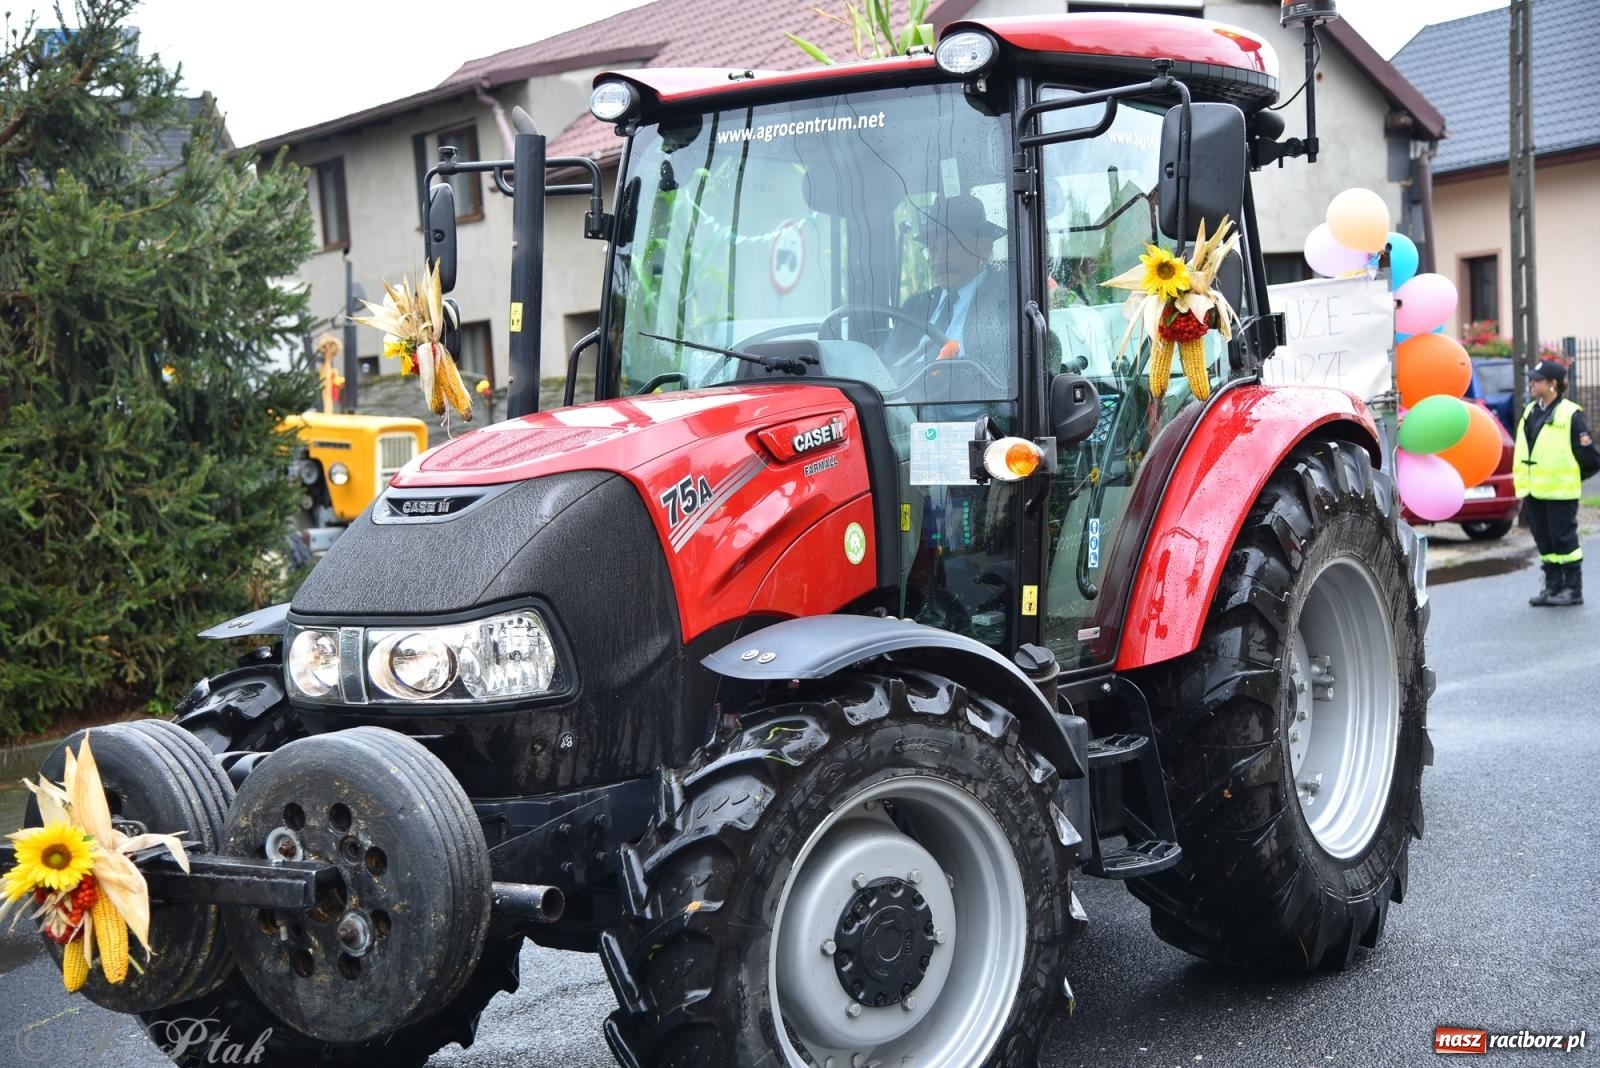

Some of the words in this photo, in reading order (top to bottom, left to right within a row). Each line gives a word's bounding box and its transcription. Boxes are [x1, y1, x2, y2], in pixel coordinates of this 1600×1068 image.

[717, 111, 886, 144] www.agrocentrum.net
[803, 454, 838, 478] FARMALL
[659, 473, 715, 529] 75A
